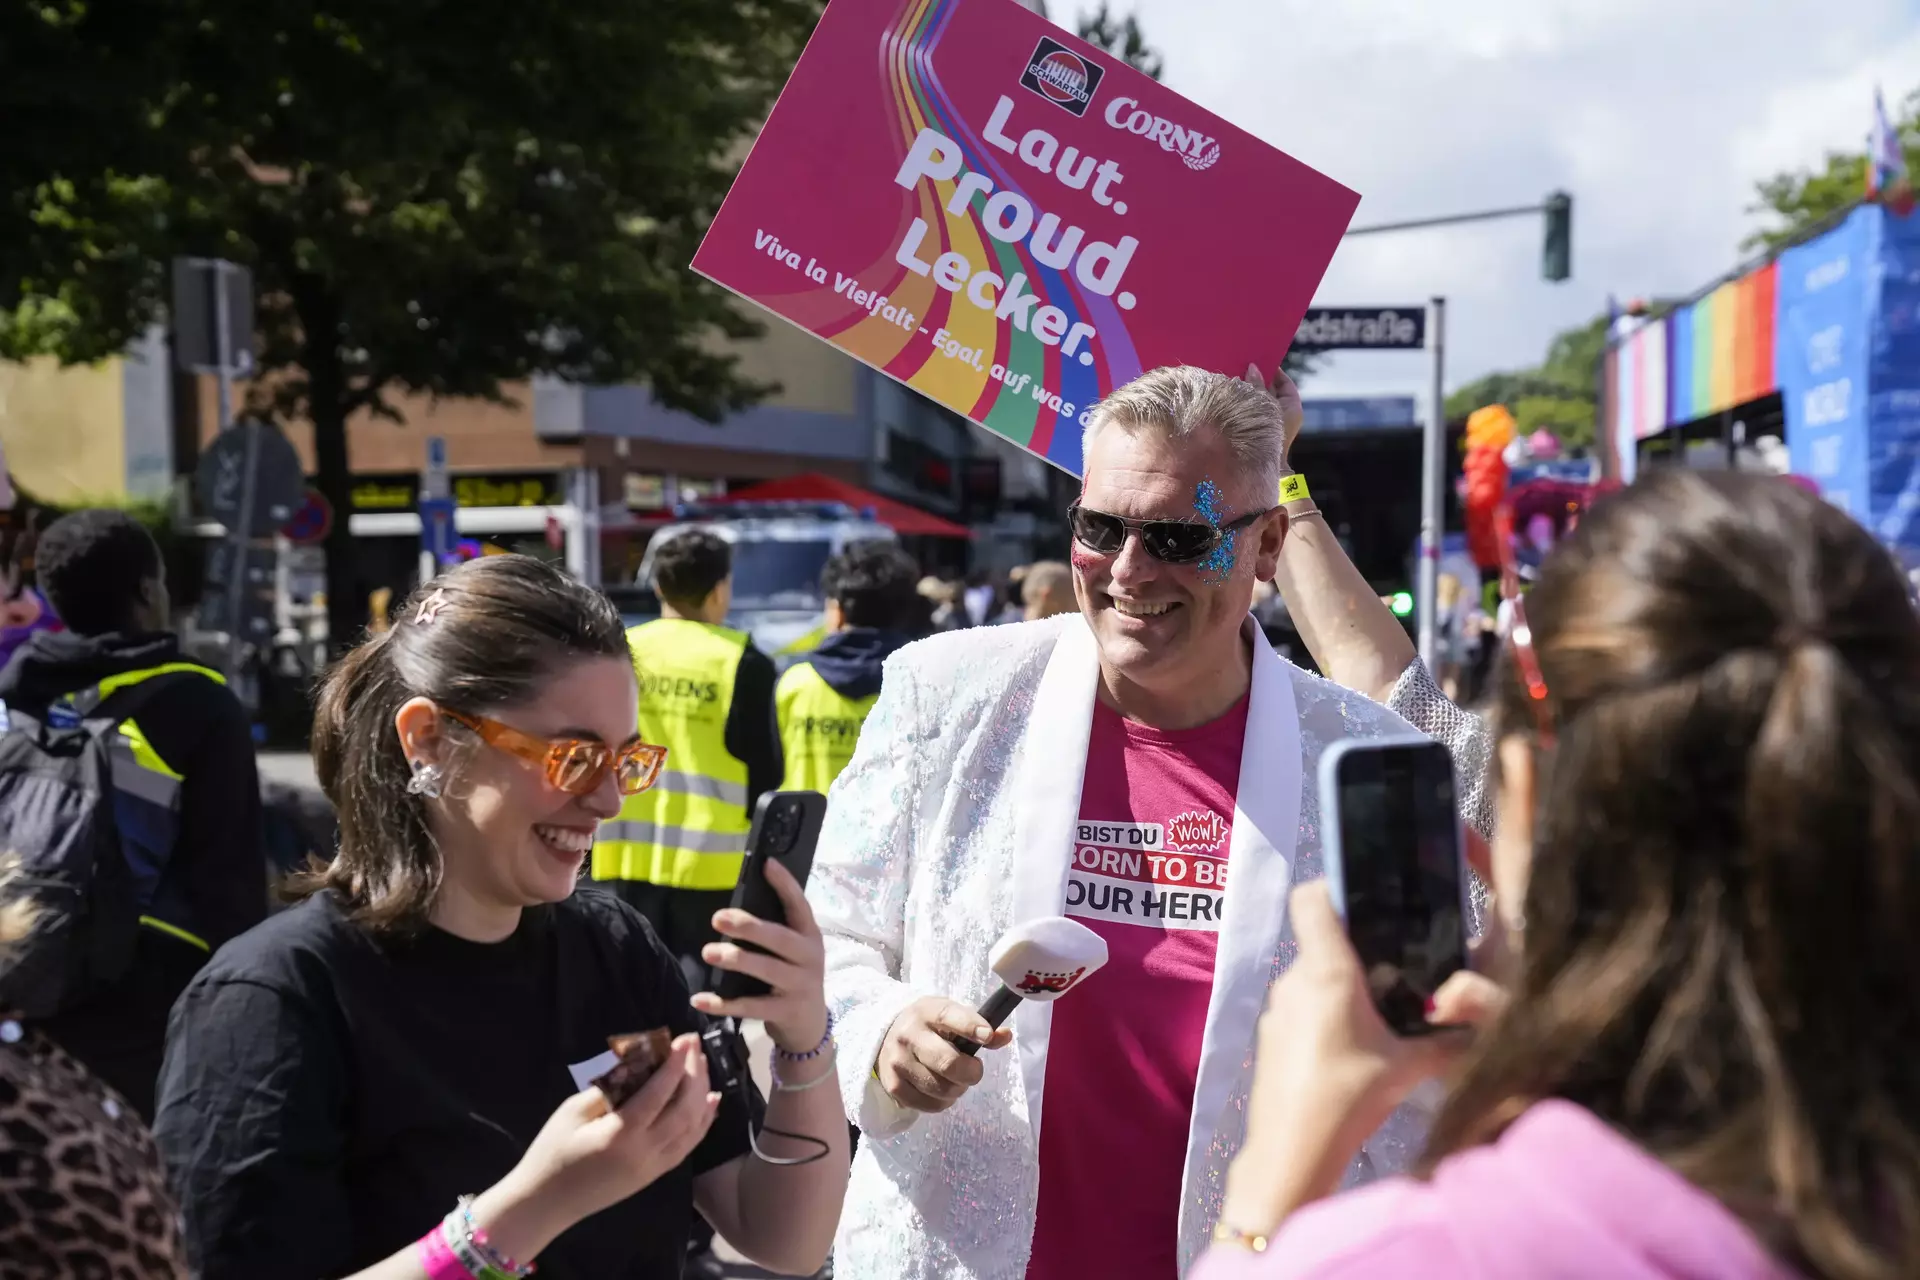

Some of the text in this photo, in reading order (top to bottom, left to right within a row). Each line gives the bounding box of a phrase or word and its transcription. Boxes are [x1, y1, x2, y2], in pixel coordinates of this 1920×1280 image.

[1030, 65, 1088, 102] SCHWARTAU
[1104, 97, 1215, 158] CORNY
[982, 94, 1128, 215] Laut.
[894, 127, 1140, 310] Proud.
[754, 228, 801, 270] Viva
[804, 257, 828, 285] la
[833, 272, 916, 332] Vielfalt
[931, 327, 984, 373] Egal,
[989, 363, 1032, 395] auf
[1031, 384, 1076, 419] was
[895, 217, 1096, 366] Lecker.
[1077, 825, 1157, 845] BIST DU
[1147, 856, 1187, 881] TO
